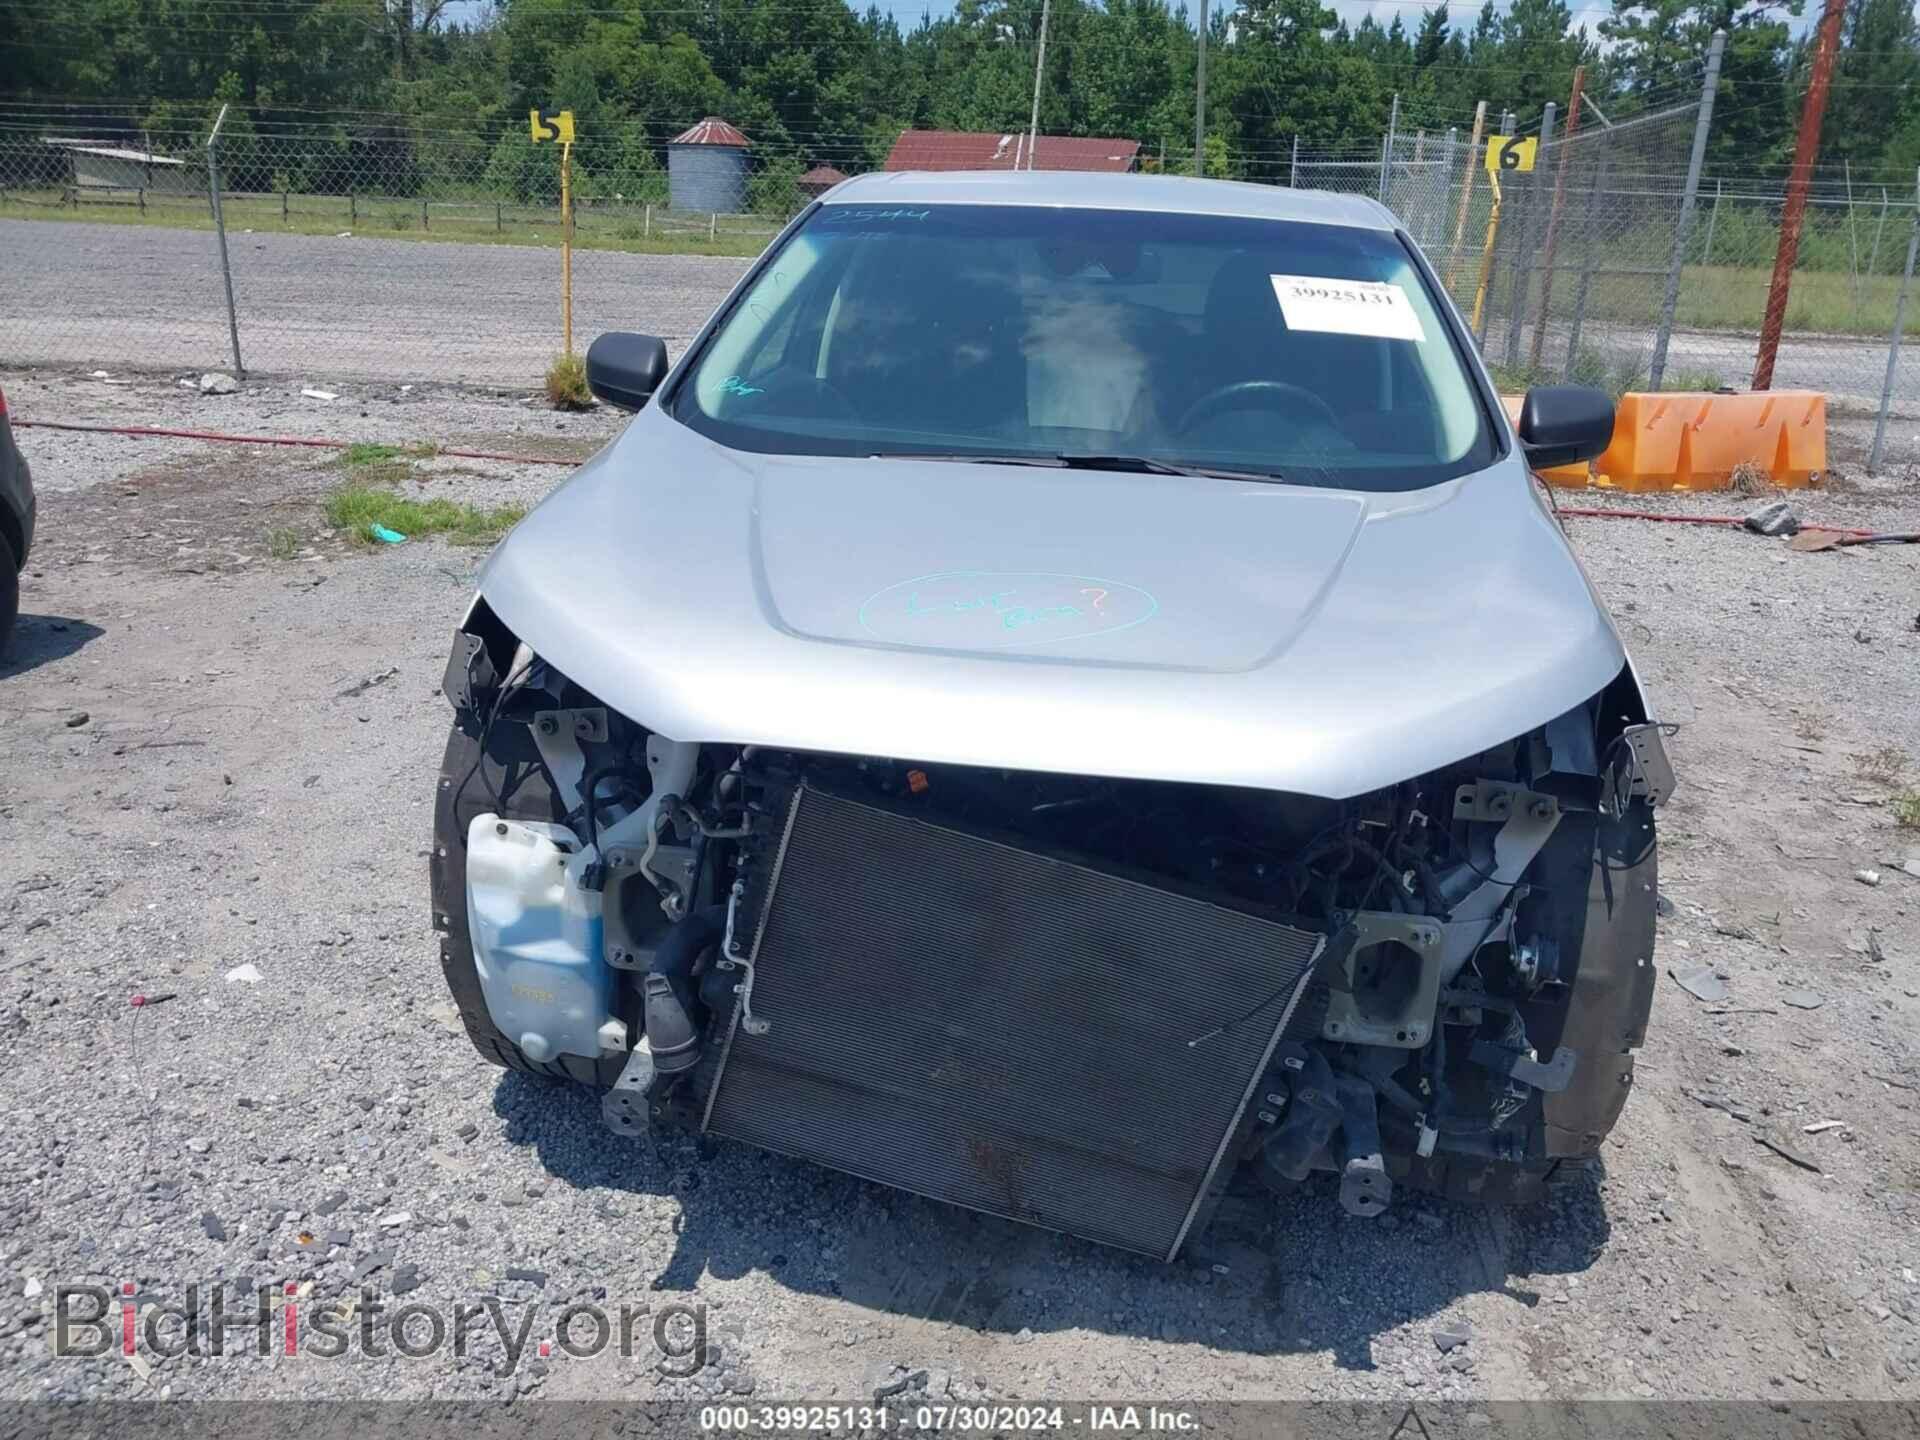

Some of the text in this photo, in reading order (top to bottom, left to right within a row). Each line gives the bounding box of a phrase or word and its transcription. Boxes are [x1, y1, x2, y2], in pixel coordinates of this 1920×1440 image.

[537, 110, 560, 144] 5
[1500, 136, 1526, 170] 6
[1291, 287, 1393, 305] 39925131
